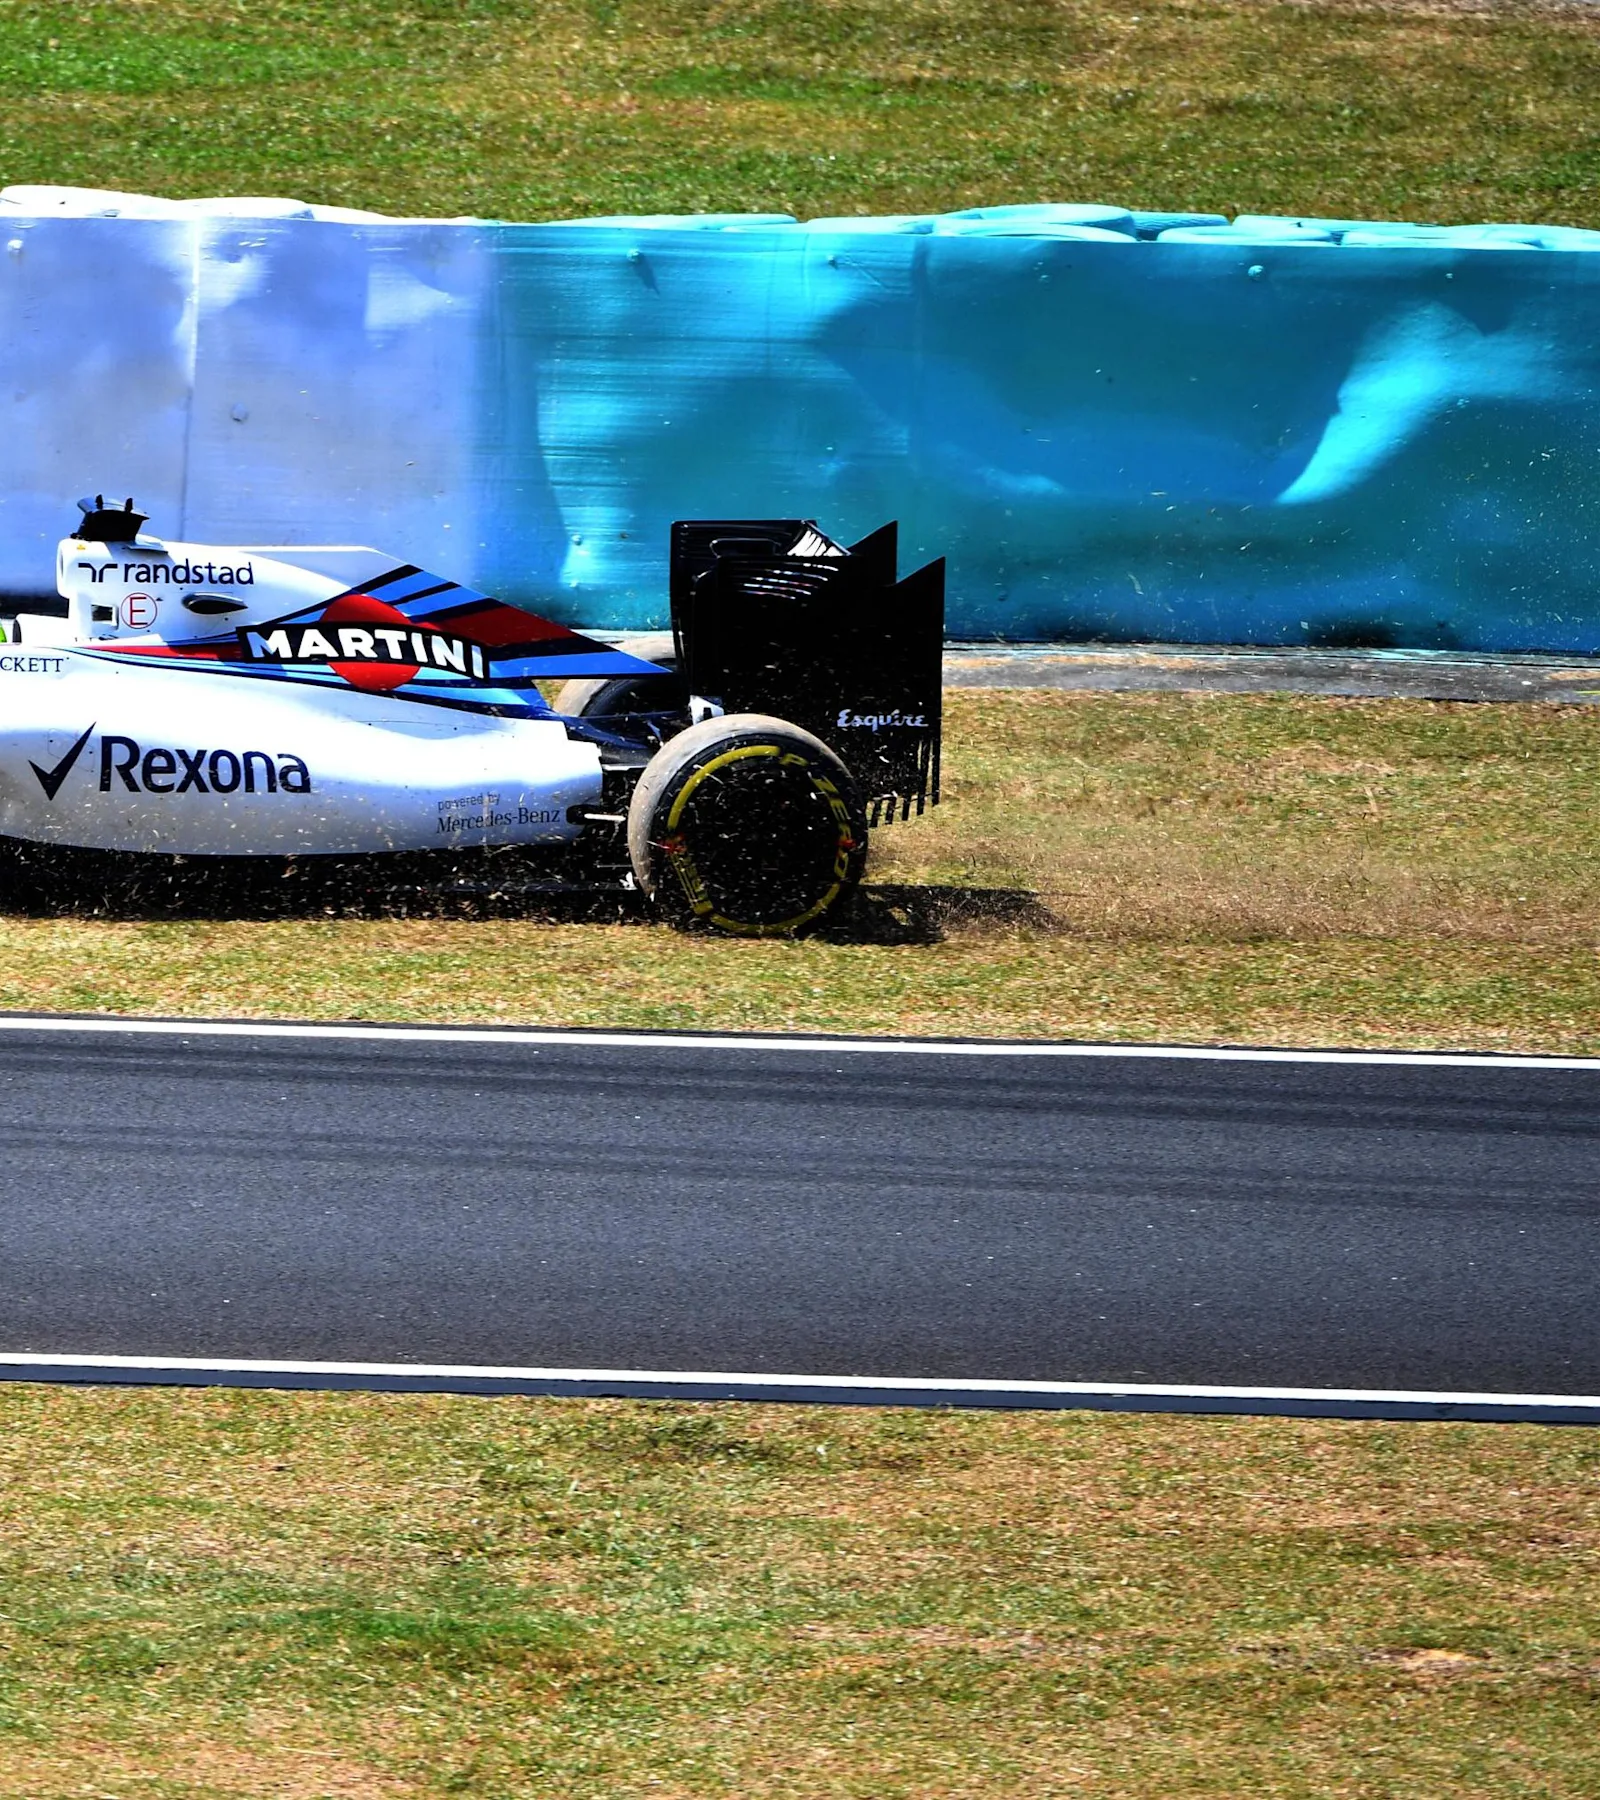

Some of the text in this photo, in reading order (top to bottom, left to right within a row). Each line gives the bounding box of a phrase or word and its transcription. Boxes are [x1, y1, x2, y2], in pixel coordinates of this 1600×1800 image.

[124, 558, 254, 585] randstad
[129, 596, 149, 626] E
[246, 628, 485, 679] MARTINI
[837, 708, 929, 731] Esquire
[100, 735, 312, 794] Rexona
[437, 793, 483, 814] powered
[436, 807, 561, 834] Mercedes-Benz
